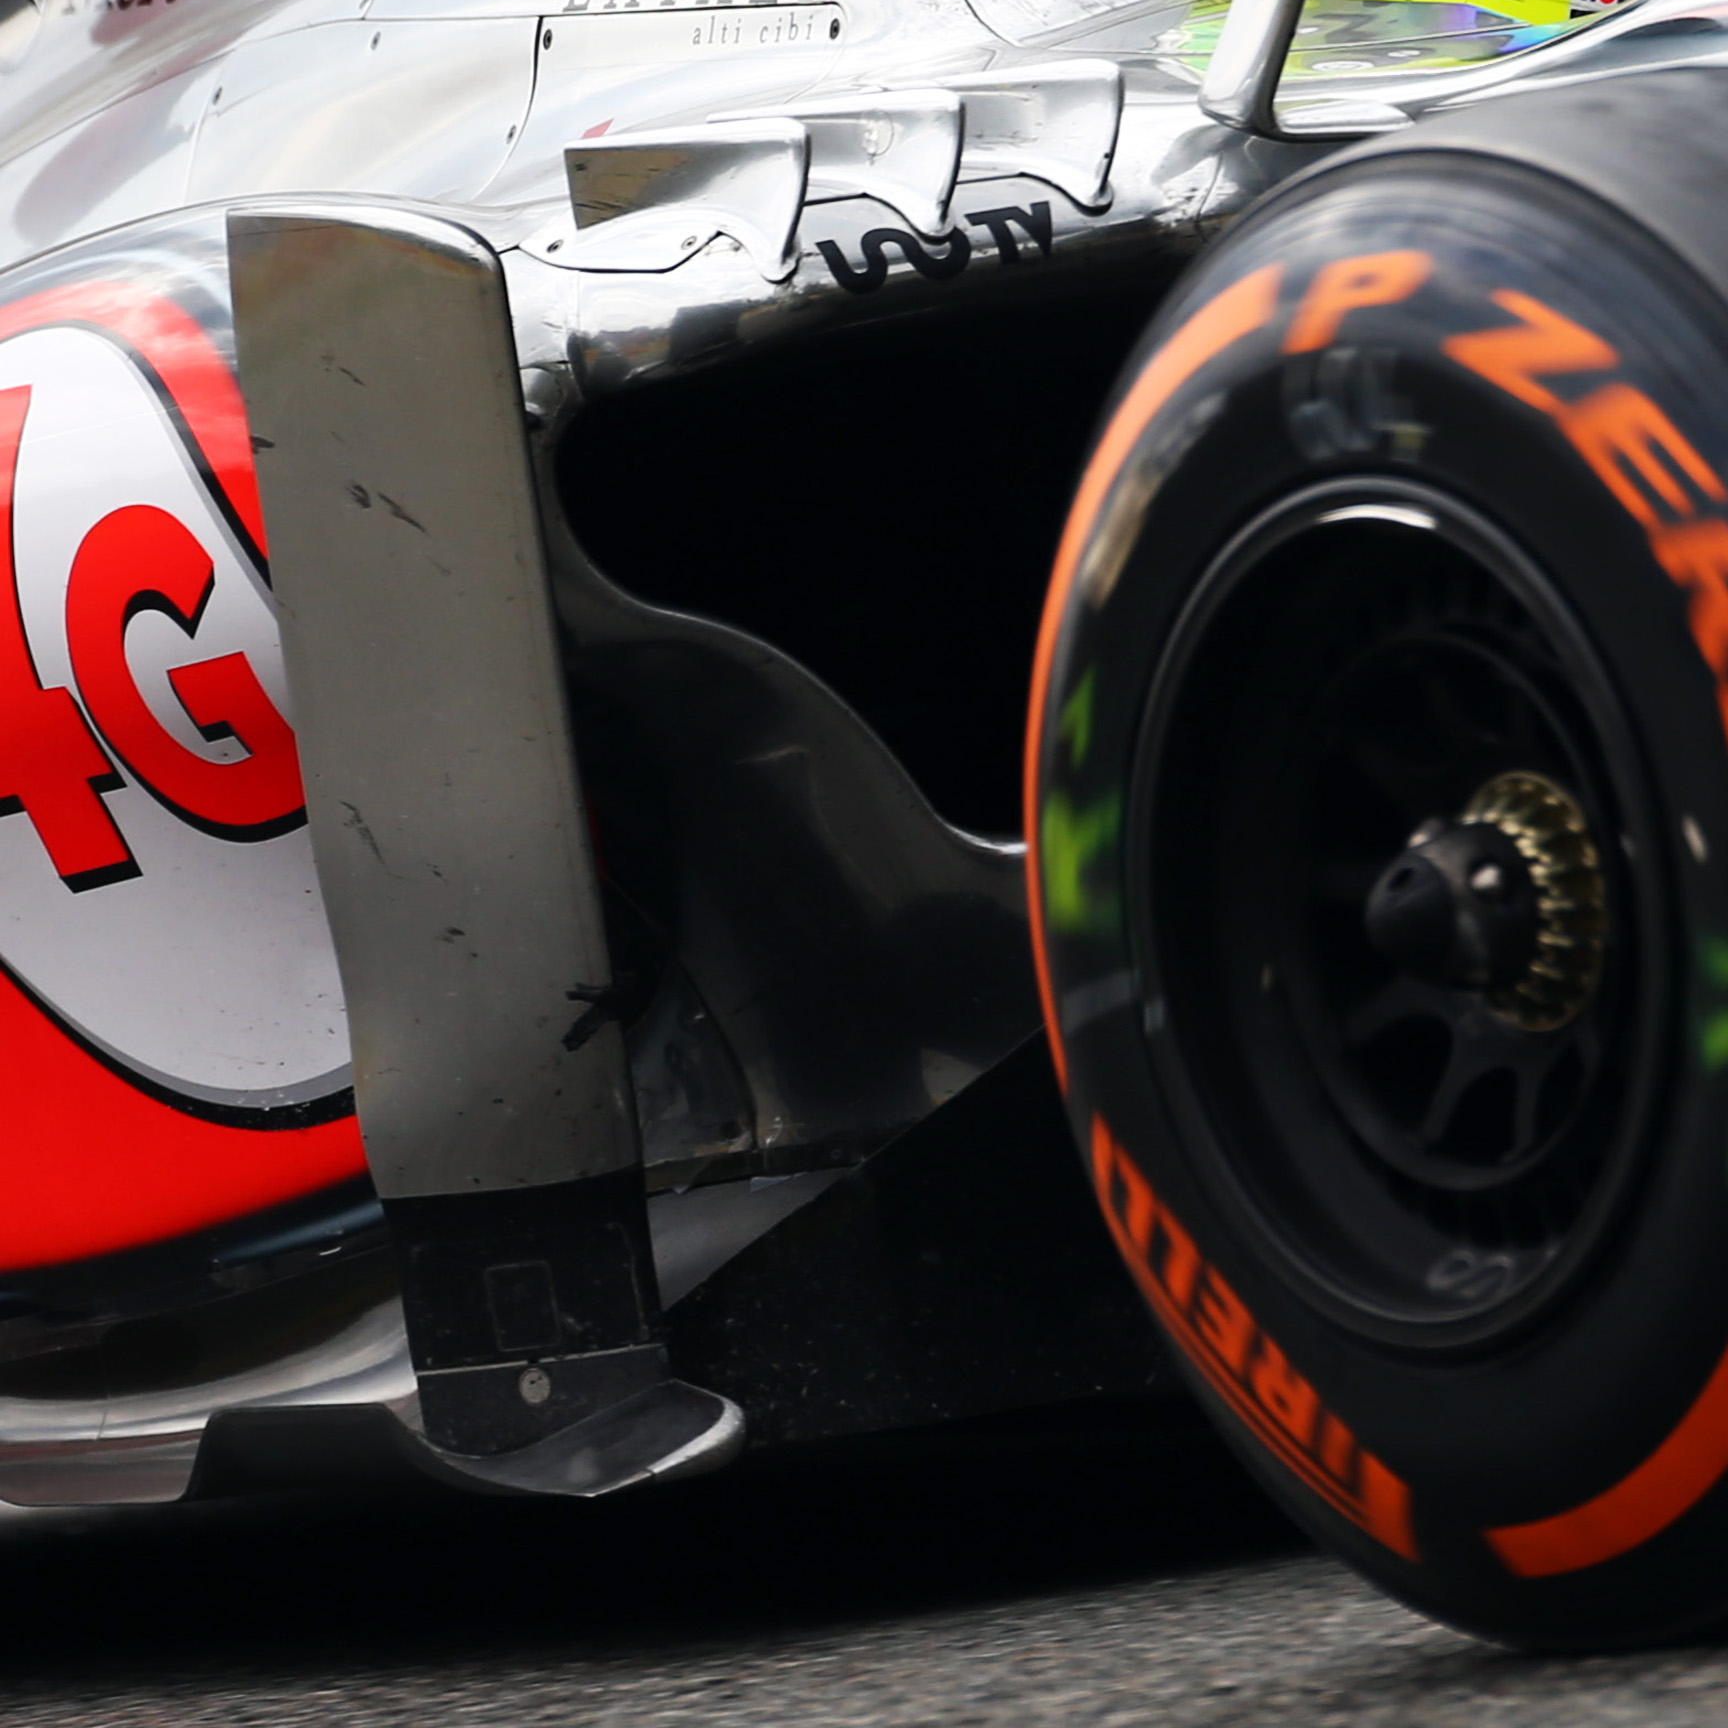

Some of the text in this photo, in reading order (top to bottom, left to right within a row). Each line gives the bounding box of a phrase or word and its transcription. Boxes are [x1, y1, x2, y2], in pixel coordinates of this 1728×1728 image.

[692, 12, 815, 45] alti cibi
[1284, 251, 1433, 355] P
